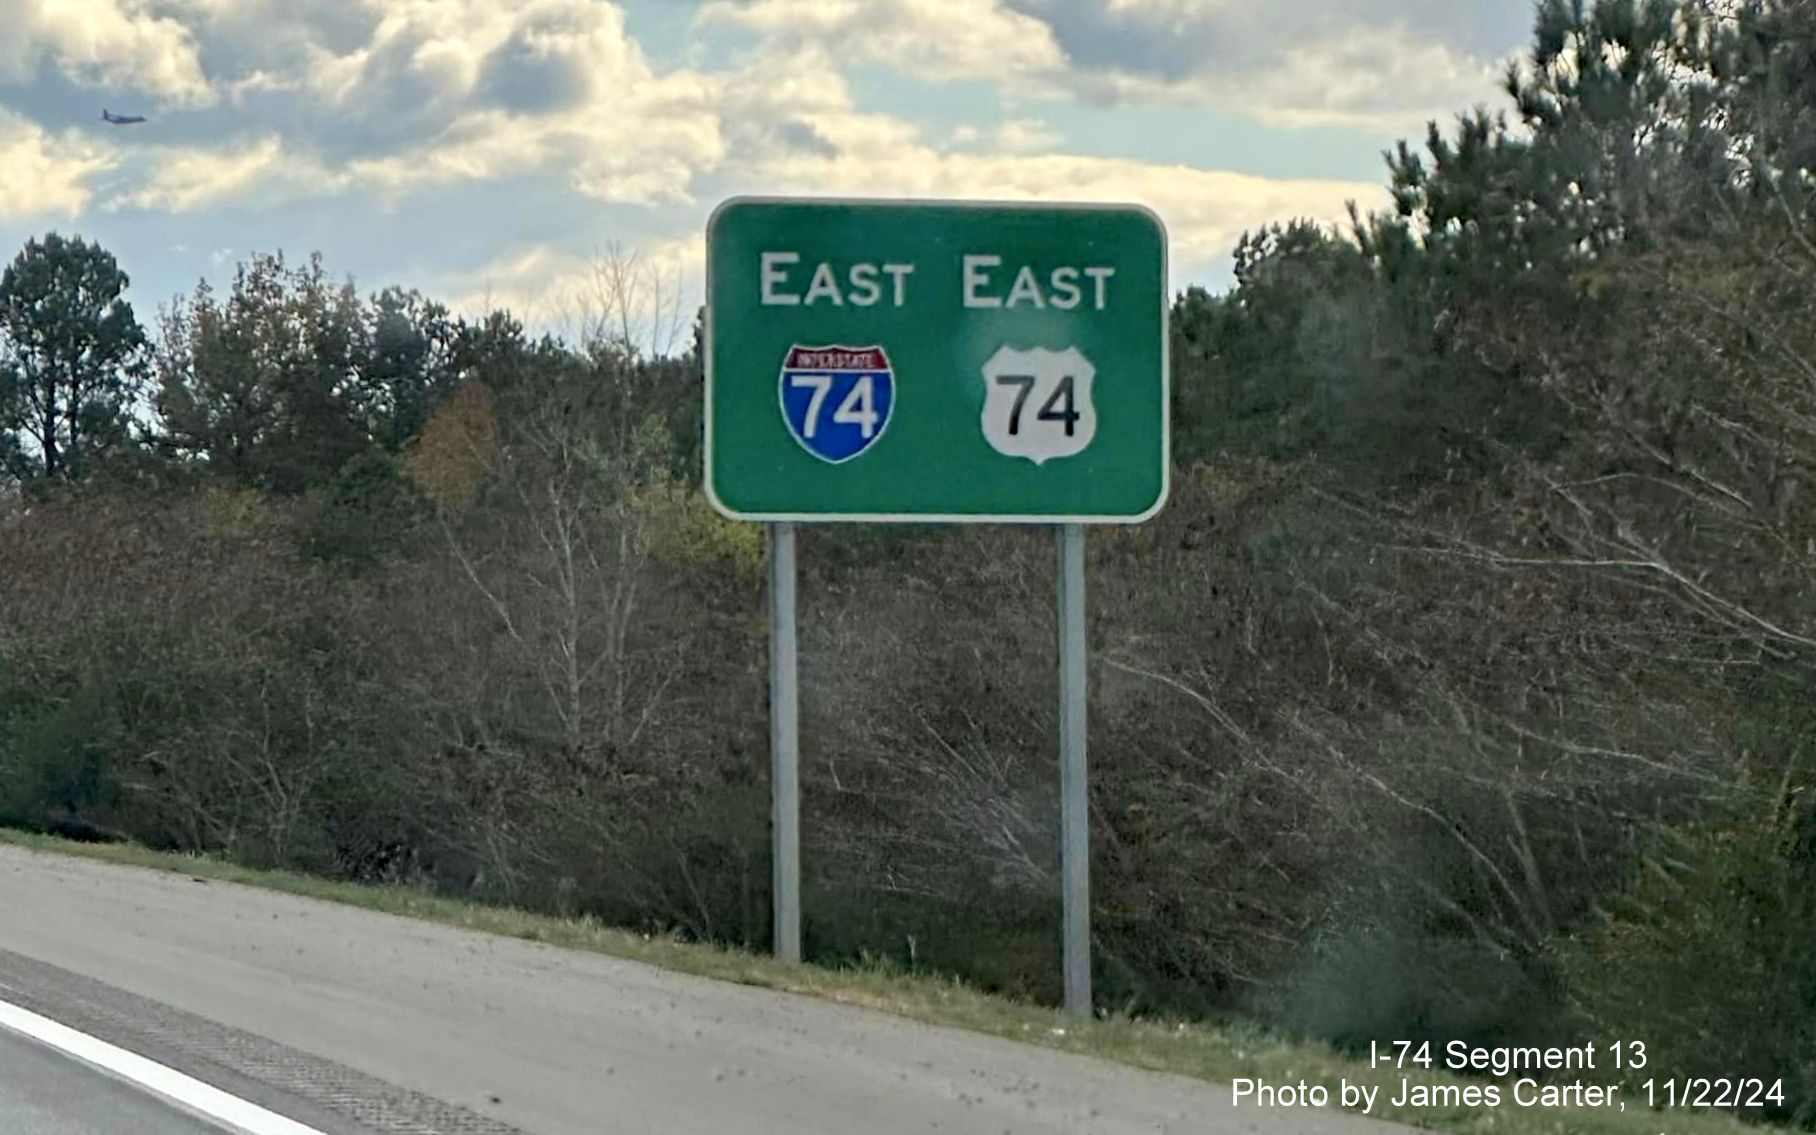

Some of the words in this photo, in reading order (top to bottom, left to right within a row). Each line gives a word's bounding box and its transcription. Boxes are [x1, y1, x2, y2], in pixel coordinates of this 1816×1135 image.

[760, 251, 915, 307] EAST
[962, 254, 1115, 310] EAST
[790, 375, 878, 439] 74
[995, 375, 1081, 438] 74
